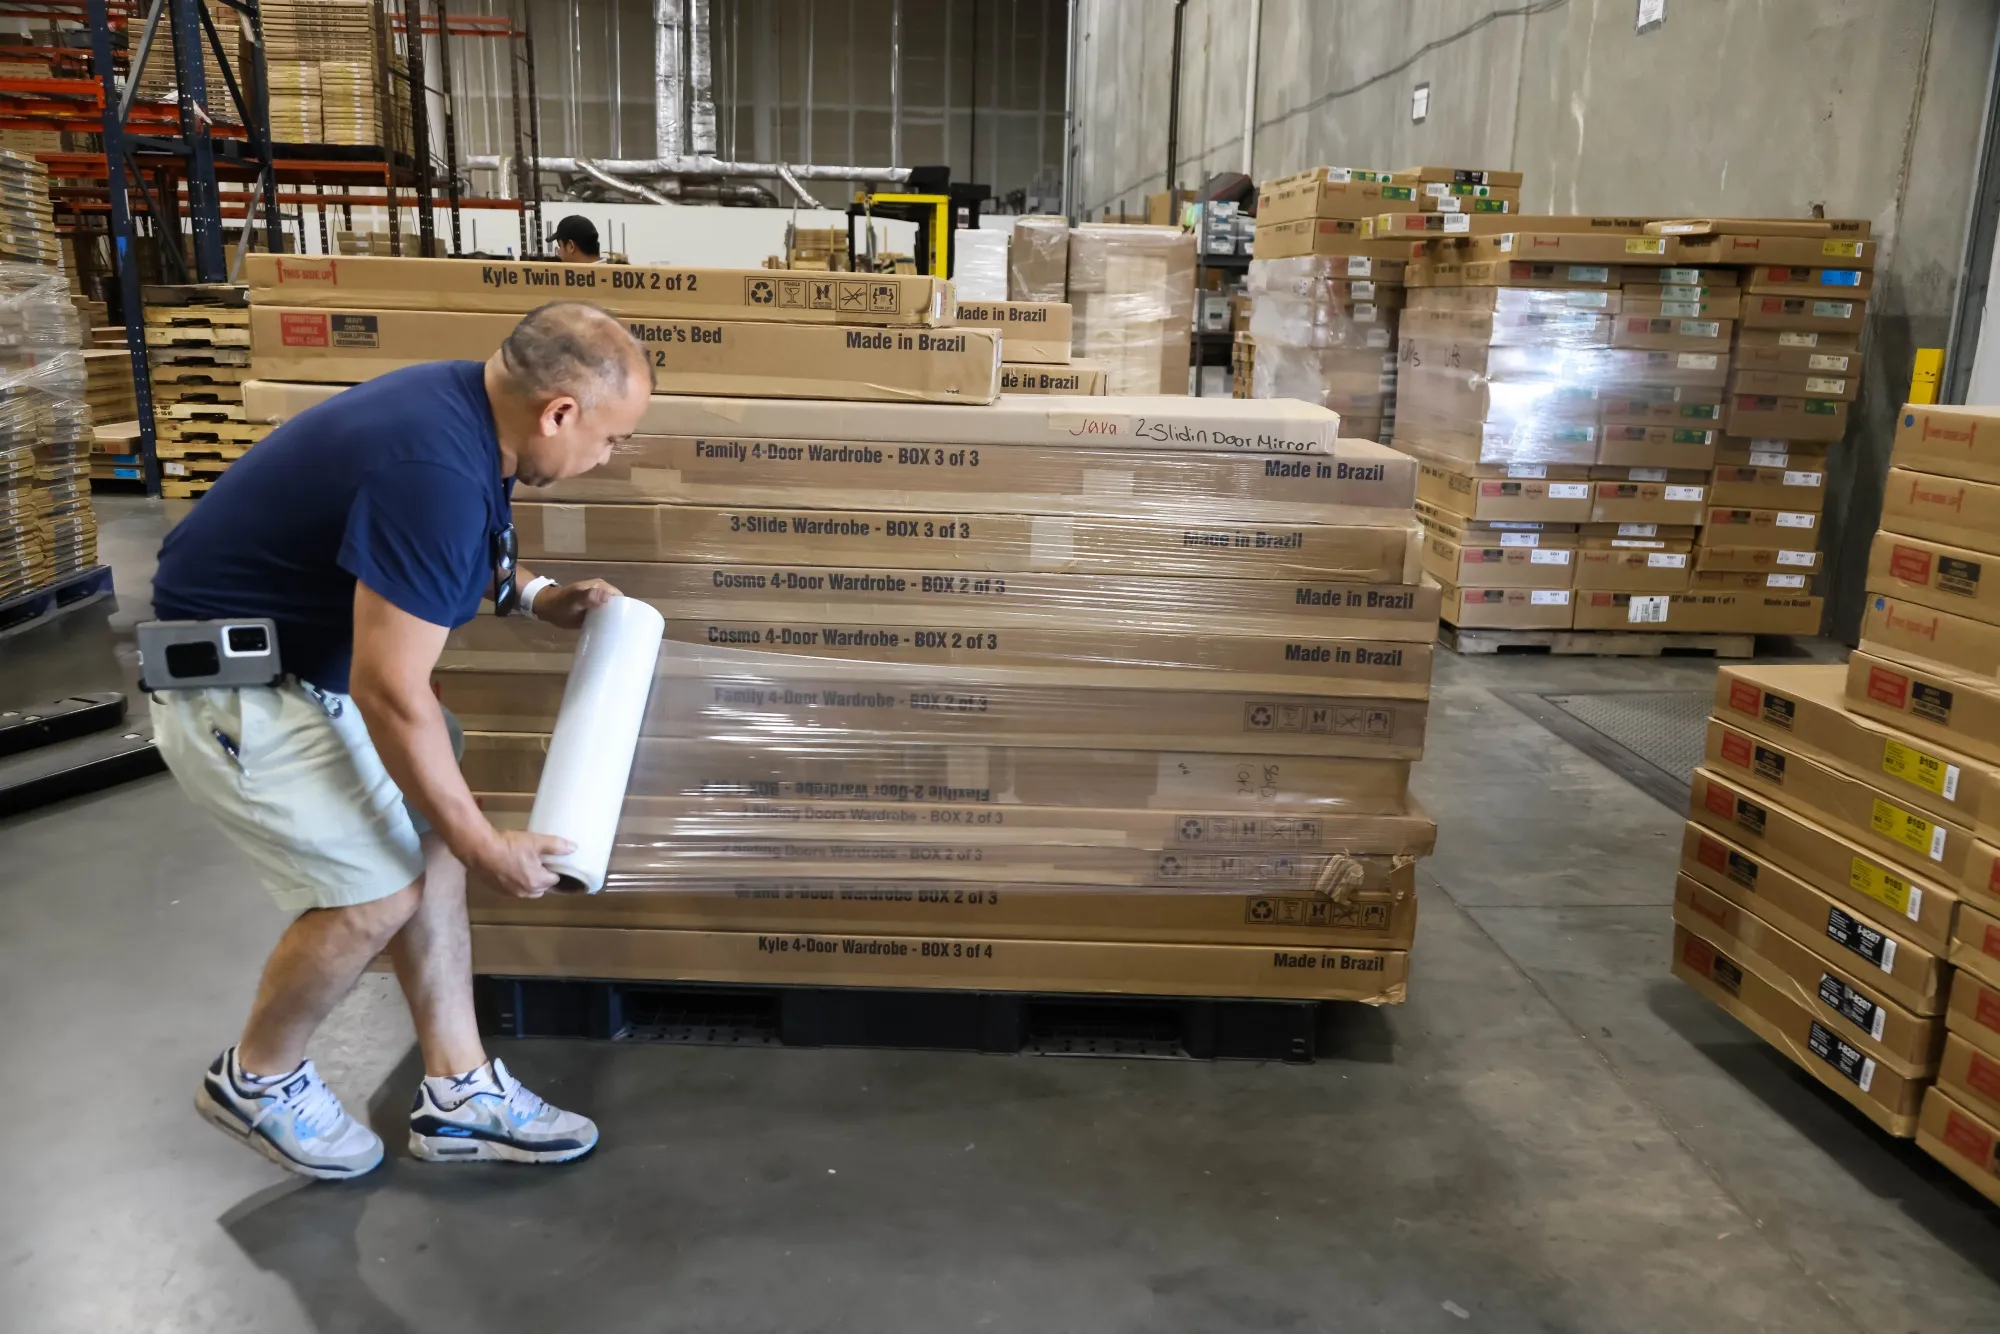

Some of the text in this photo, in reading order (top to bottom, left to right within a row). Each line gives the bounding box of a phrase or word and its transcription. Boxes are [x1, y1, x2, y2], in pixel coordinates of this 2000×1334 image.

[482, 266, 519, 288] Kyle
[523, 267, 560, 287] Twin
[565, 269, 596, 288] Bed
[612, 270, 646, 290] BOX
[650, 271, 661, 290] 2
[665, 272, 682, 291] of
[686, 273, 698, 292] 2
[956, 306, 1047, 322] Made in Brazil
[691, 325, 722, 344] Bed
[846, 331, 966, 353] Made in Brazil
[656, 350, 666, 367] 2
[1001, 373, 1079, 390] de in Brazil
[1069, 418, 1118, 436] Java
[1213, 431, 1253, 447] Door
[1257, 435, 1318, 452] Mirror
[695, 440, 748, 463] Family
[751, 443, 804, 462] 4-Door
[808, 445, 883, 465] Wardrobe
[898, 448, 931, 466] BOX
[935, 450, 945, 466] 3
[949, 449, 967, 467] of
[969, 450, 980, 467] 3
[1265, 460, 1385, 481] Made in Brazil
[730, 515, 788, 534] 3-Slide
[792, 517, 870, 536] Wardrobe
[886, 520, 919, 538] BOX
[923, 522, 934, 538] 3
[938, 522, 956, 539] of
[959, 523, 971, 539] 3
[1183, 531, 1303, 550] Made in Brazil
[712, 571, 766, 589] Cosmo
[770, 572, 825, 591] 4-Door
[828, 574, 906, 592] Wardrobe
[921, 576, 955, 593] BOX
[959, 577, 970, 594] 2
[973, 577, 991, 594] of
[1295, 588, 1414, 610] Made in Brazil
[708, 626, 761, 644] Cosmo
[765, 628, 818, 645] 4-Door
[822, 629, 899, 647] Wardrobe
[914, 631, 947, 649] BOX
[952, 632, 962, 649] 2
[966, 632, 984, 650] of
[987, 633, 998, 650] 3
[1285, 644, 1403, 667] Made in Brazil
[714, 687, 764, 706] Family
[768, 688, 818, 706] 4-Door
[823, 690, 896, 708] Wardrobe
[910, 693, 941, 710] BOX
[805, 806, 846, 820] Doors
[850, 808, 917, 822] Wardrobe
[930, 811, 961, 823] BOX
[965, 812, 974, 823] 2
[977, 812, 993, 824] of
[995, 812, 1004, 824] 3
[910, 848, 941, 861] BOX
[945, 849, 953, 861] 2
[974, 849, 983, 862] 3
[918, 890, 950, 904] BOX
[954, 891, 963, 904] 2
[967, 891, 984, 905] of
[987, 891, 998, 905] 3
[758, 936, 789, 954] Kyle
[792, 938, 838, 954] 4-Door
[842, 939, 907, 956] Wardrobe
[921, 941, 949, 957] BOX
[953, 943, 962, 957] 3
[965, 943, 980, 958] of
[984, 944, 993, 958] 4
[1273, 953, 1385, 972] Made in Brazil
